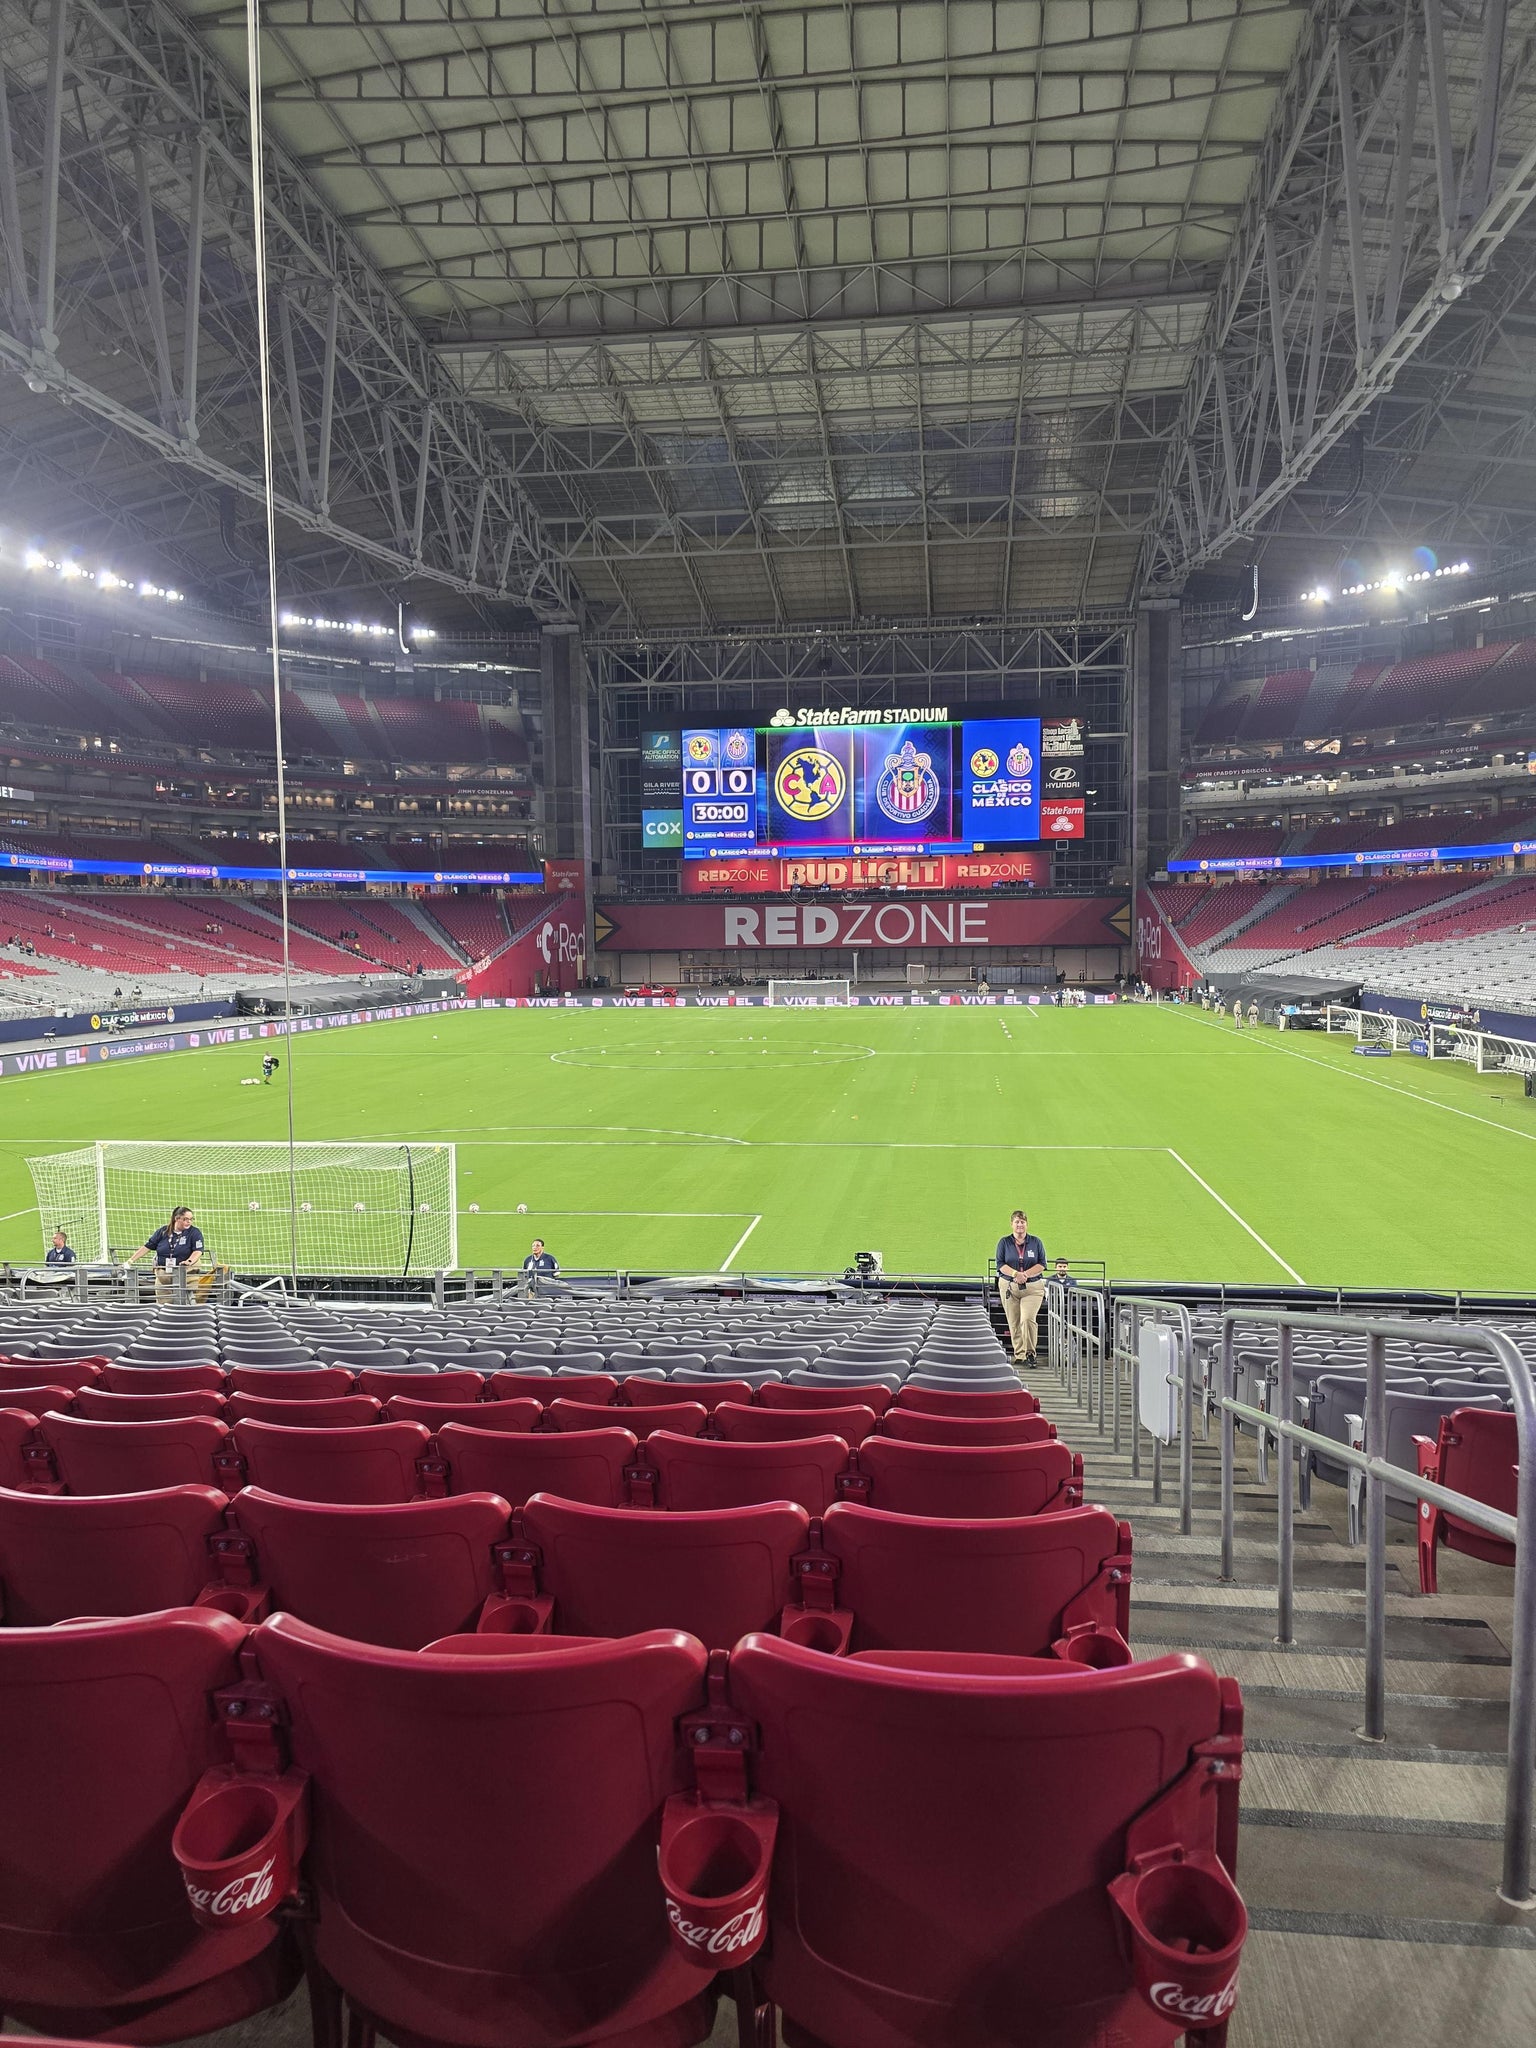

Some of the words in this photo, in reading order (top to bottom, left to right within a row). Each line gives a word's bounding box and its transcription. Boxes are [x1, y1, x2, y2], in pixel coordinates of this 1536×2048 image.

[884, 707, 948, 722] STADIUM
[1456, 745, 1479, 753] GREEN
[692, 771, 710, 793] 0
[729, 770, 747, 792] 0
[972, 782, 1032, 794] CLÁSICO
[882, 798, 911, 818] DEPORTIVO
[912, 778, 934, 818] GUADALAJARA
[972, 796, 1032, 807] MÉXICO
[696, 805, 744, 820] 30:00
[646, 822, 681, 835] COX
[698, 869, 768, 882] REDZONE
[787, 863, 847, 885] BUD
[852, 862, 939, 884] LIGHT
[957, 864, 1032, 877] REDZONE
[724, 903, 989, 946] REDZONE
[451, 999, 476, 1008] VIVE
[484, 998, 500, 1007] EL
[527, 998, 558, 1006] VIVE
[565, 998, 583, 1006] EL
[612, 998, 646, 1007] VIVE
[652, 998, 669, 1006] EL
[695, 998, 728, 1006] VIVE
[784, 997, 817, 1005] VIVE
[825, 997, 842, 1005] EL
[869, 997, 903, 1005] VIVE
[911, 997, 929, 1005] EL
[960, 996, 996, 1005] VIVE
[1004, 996, 1022, 1004] EL
[1094, 995, 1114, 1004] EL
[376, 1009, 393, 1020] VIVE
[395, 1008, 404, 1017] EL
[415, 1004, 429, 1014] VIVE
[432, 1003, 439, 1012] EL
[130, 1014, 140, 1022] DE
[141, 1012, 166, 1021] MÉXICO
[328, 1015, 348, 1026] VIVE
[351, 1014, 361, 1024] EL
[301, 1020, 313, 1030] EL
[208, 1029, 234, 1044] VIVE
[239, 1028, 253, 1039] EL
[144, 1041, 167, 1050] MÉXICO
[16, 1052, 58, 1072] VIVE
[66, 1049, 86, 1065] EL
